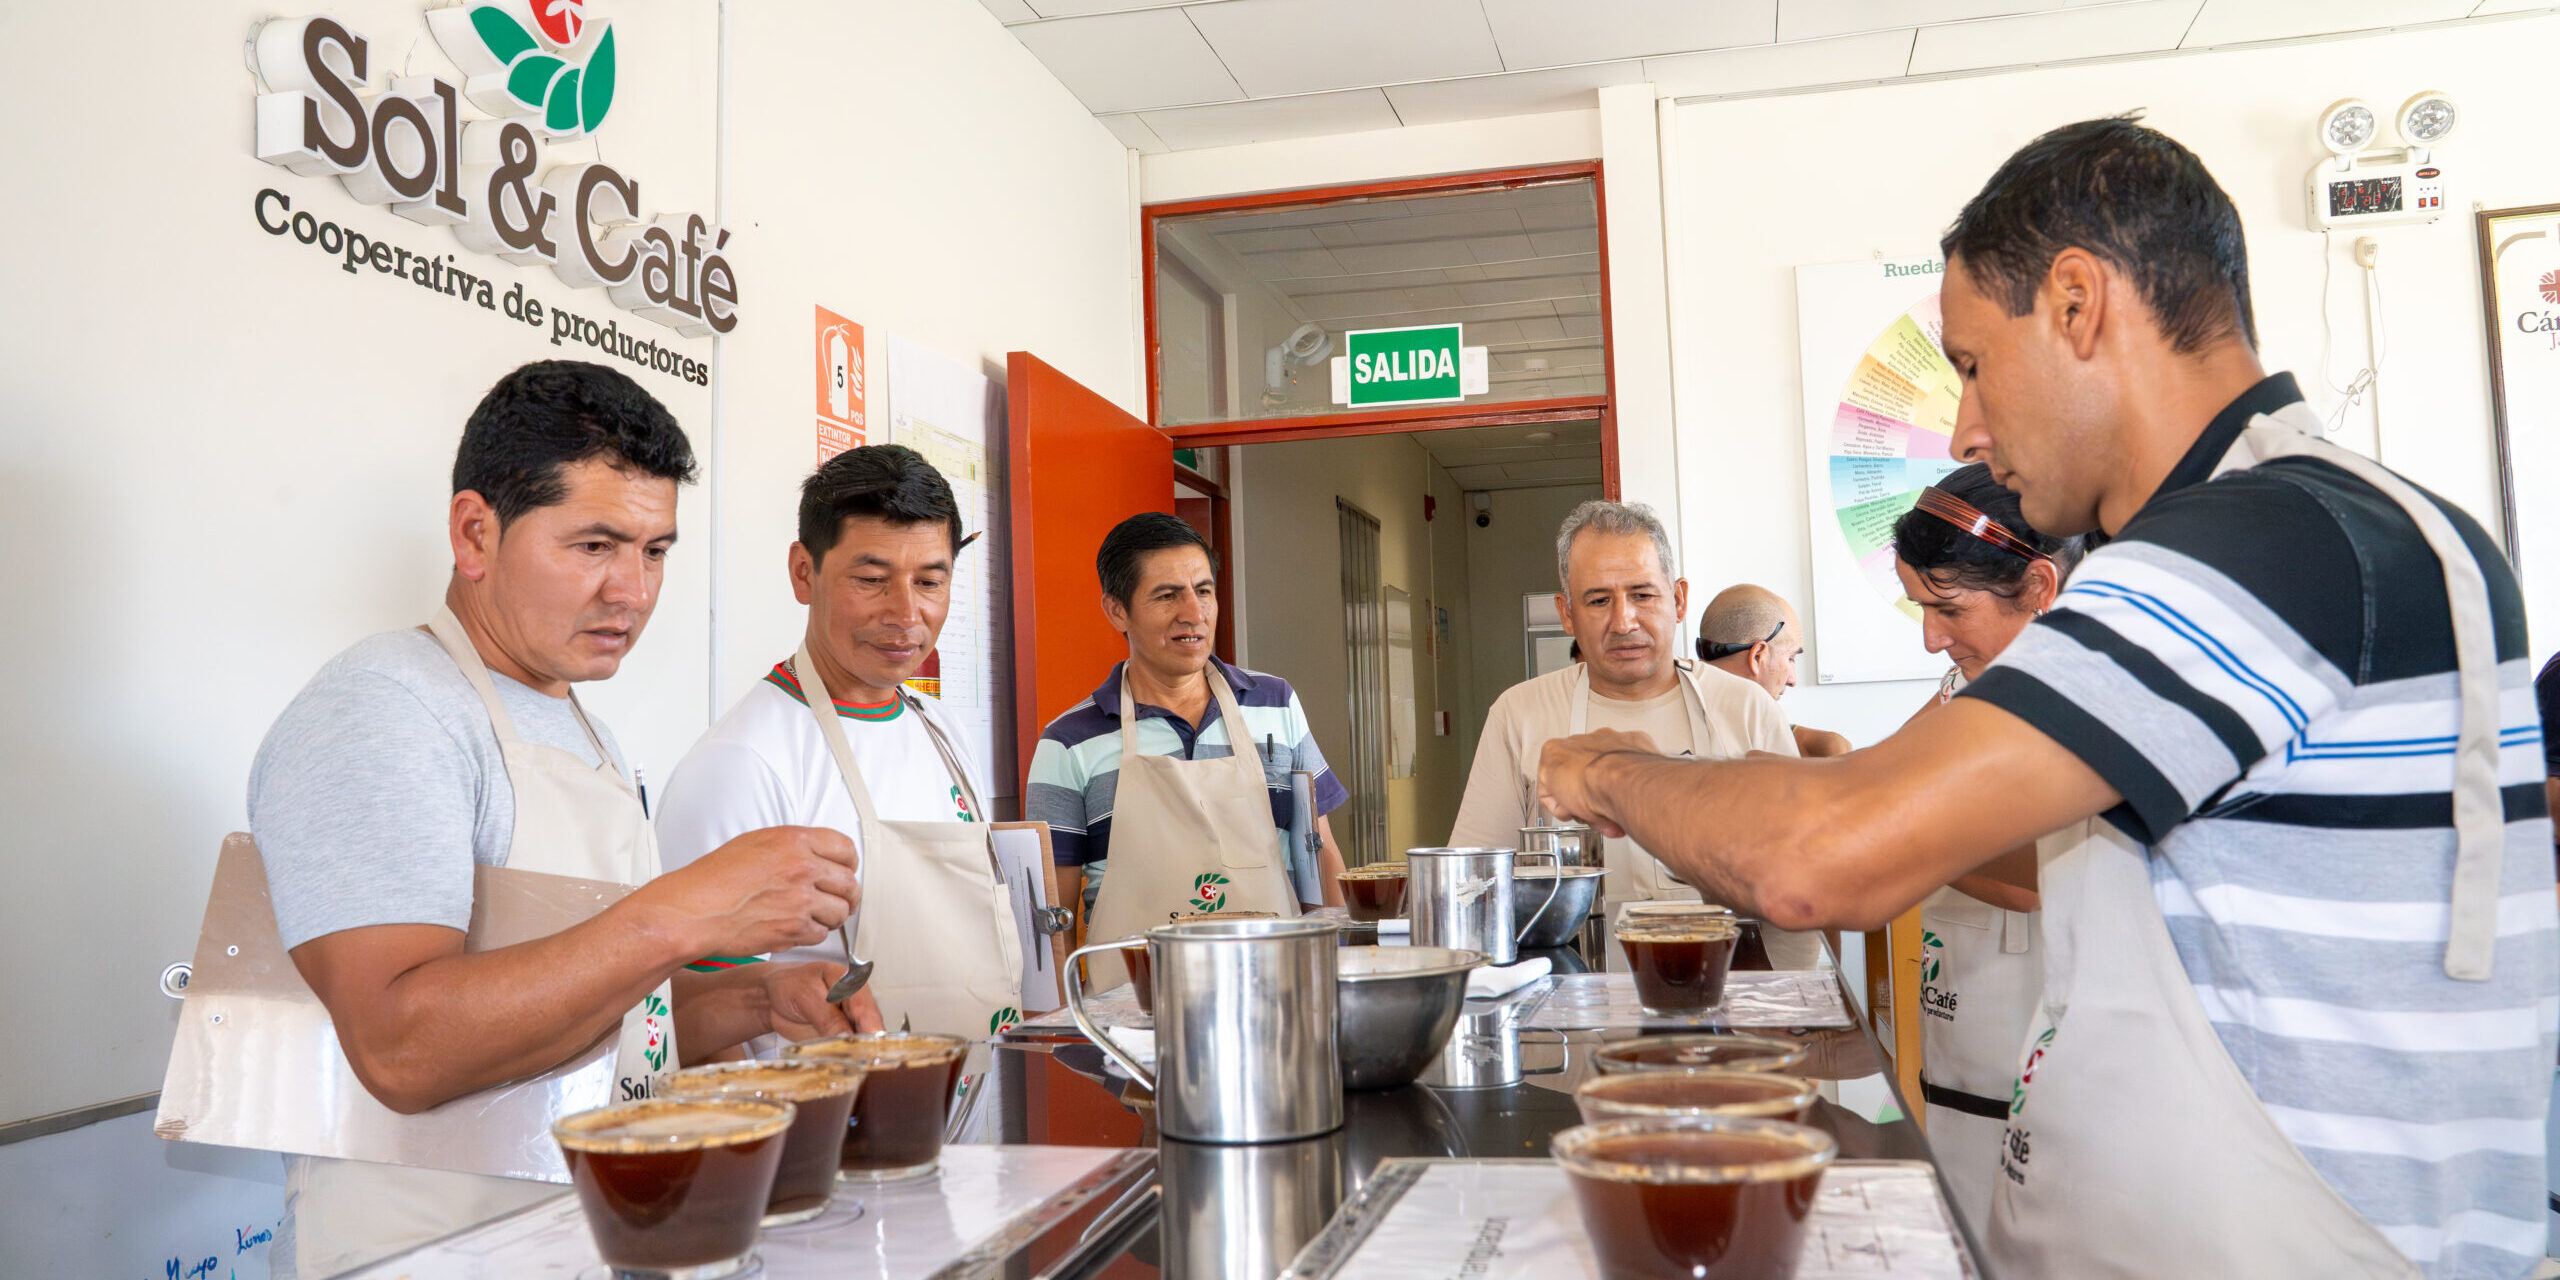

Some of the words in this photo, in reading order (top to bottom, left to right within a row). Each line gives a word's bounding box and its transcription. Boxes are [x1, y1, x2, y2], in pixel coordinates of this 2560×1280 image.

[304, 16, 467, 218] Sol
[488, 122, 557, 259] &
[576, 163, 739, 334] Café
[1883, 259, 1945, 278] Rueda
[254, 188, 495, 310] Cooperativa
[503, 282, 544, 327] de
[550, 306, 709, 387] productores
[837, 365, 844, 389] 5
[1354, 348, 1456, 384] SALIDA
[850, 409, 864, 426] PQS
[818, 423, 852, 444] EXTINTOR
[1925, 986, 1958, 1012] Café
[620, 1075, 649, 1102] Sol
